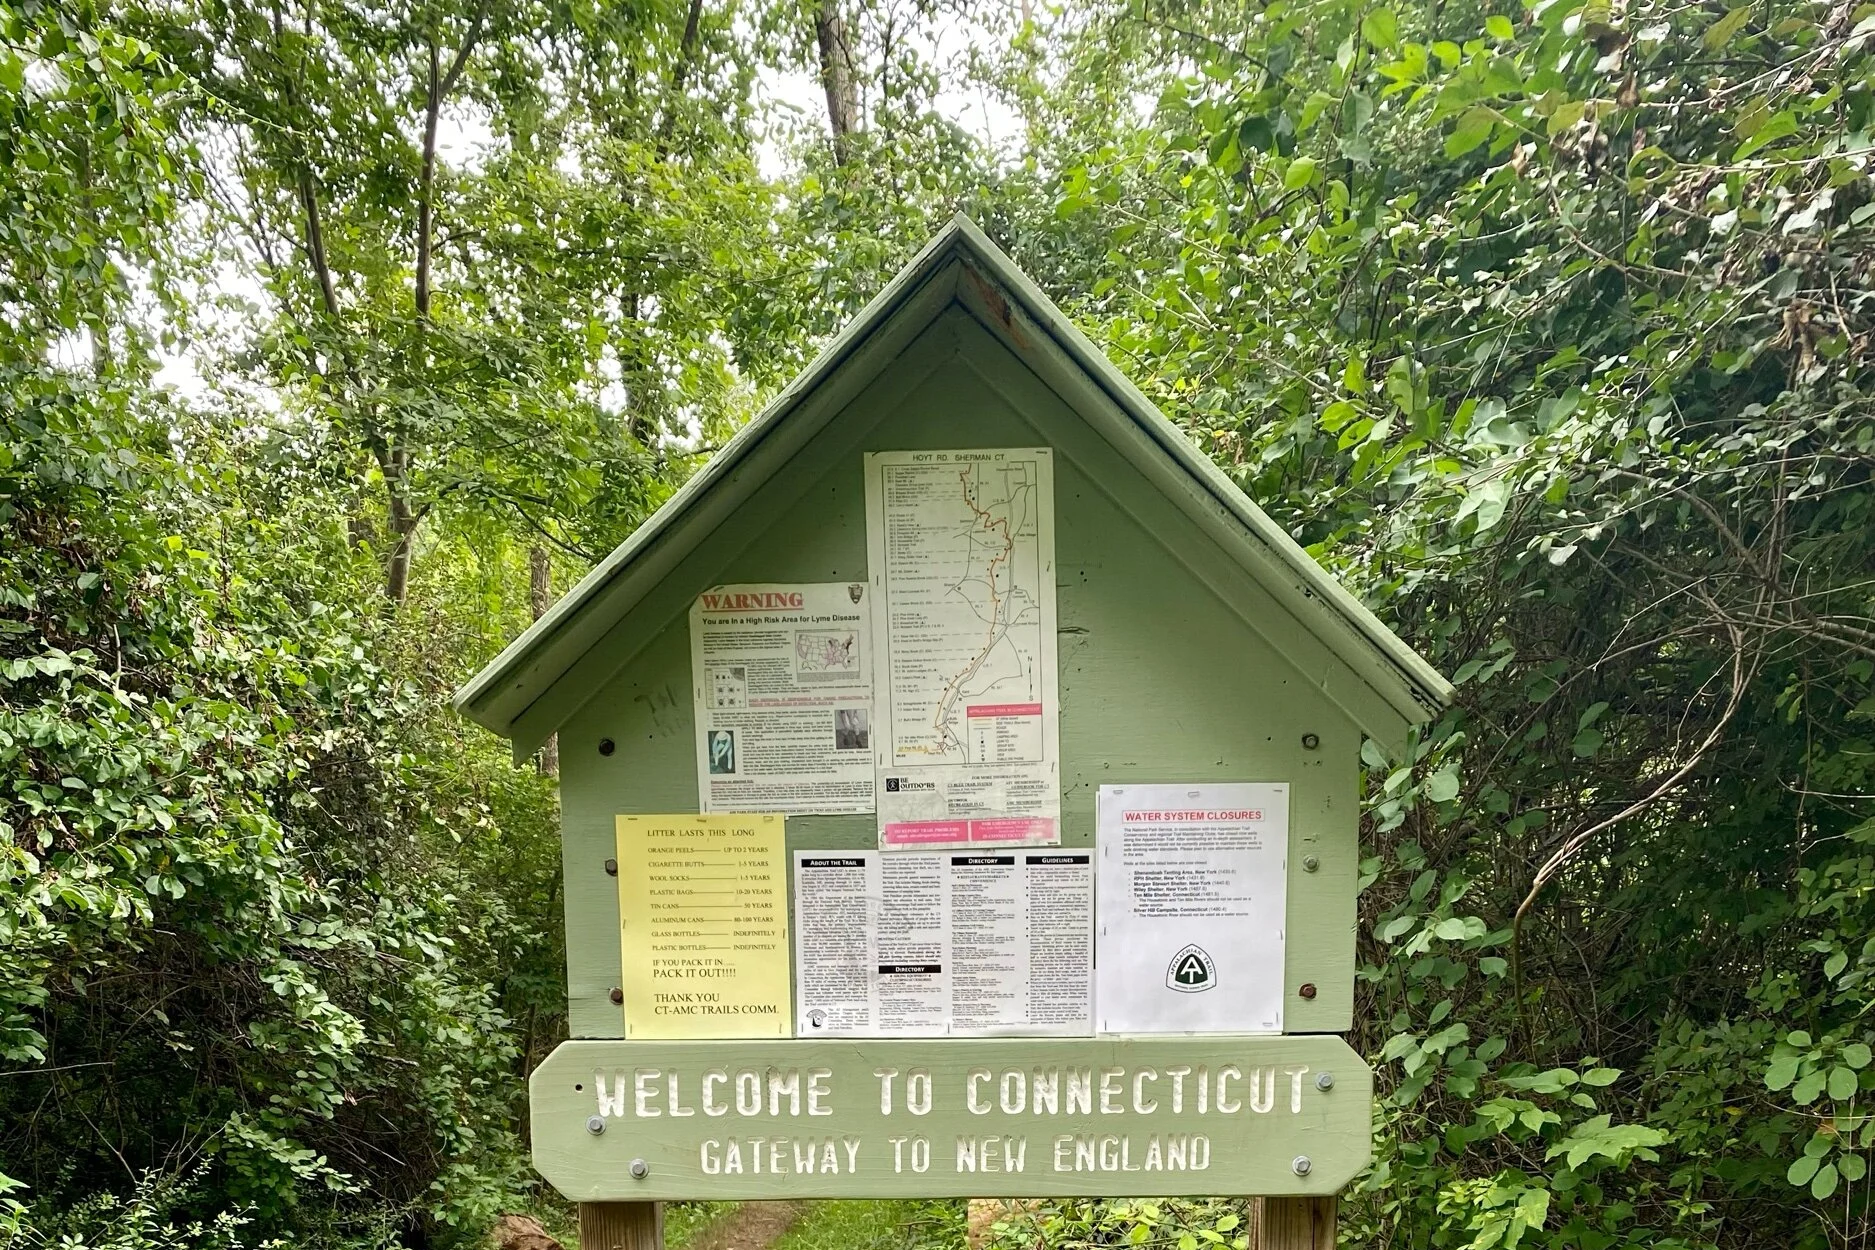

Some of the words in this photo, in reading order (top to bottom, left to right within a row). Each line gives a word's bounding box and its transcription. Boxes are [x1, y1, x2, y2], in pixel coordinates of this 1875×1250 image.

[701, 592, 803, 609] WARNING
[812, 615, 830, 623] Lyme
[1126, 812, 1161, 821] WATER
[1164, 812, 1204, 820] SYSTEM
[1208, 811, 1262, 820] CLOSURES
[1170, 948, 1202, 975] APPALACHIAN
[1203, 957, 1213, 975] TRAIL
[654, 969, 683, 978] PACK
[686, 969, 696, 977] IT
[698, 969, 736, 977] OUT!!!!
[655, 994, 693, 1002] THANK
[696, 993, 720, 1002] YOU
[655, 1006, 698, 1014] CT-AMC
[702, 1006, 739, 1014] TRAILS
[742, 1005, 779, 1014] COMM.
[593, 1065, 834, 1117] WELCOME
[873, 1066, 933, 1116] TO
[966, 1064, 1310, 1115] CONNECTICUT
[700, 1136, 861, 1175] GATEWAY
[888, 1135, 931, 1174] TO
[956, 1134, 1027, 1173] NEW
[1053, 1133, 1211, 1172] ENGLAND
